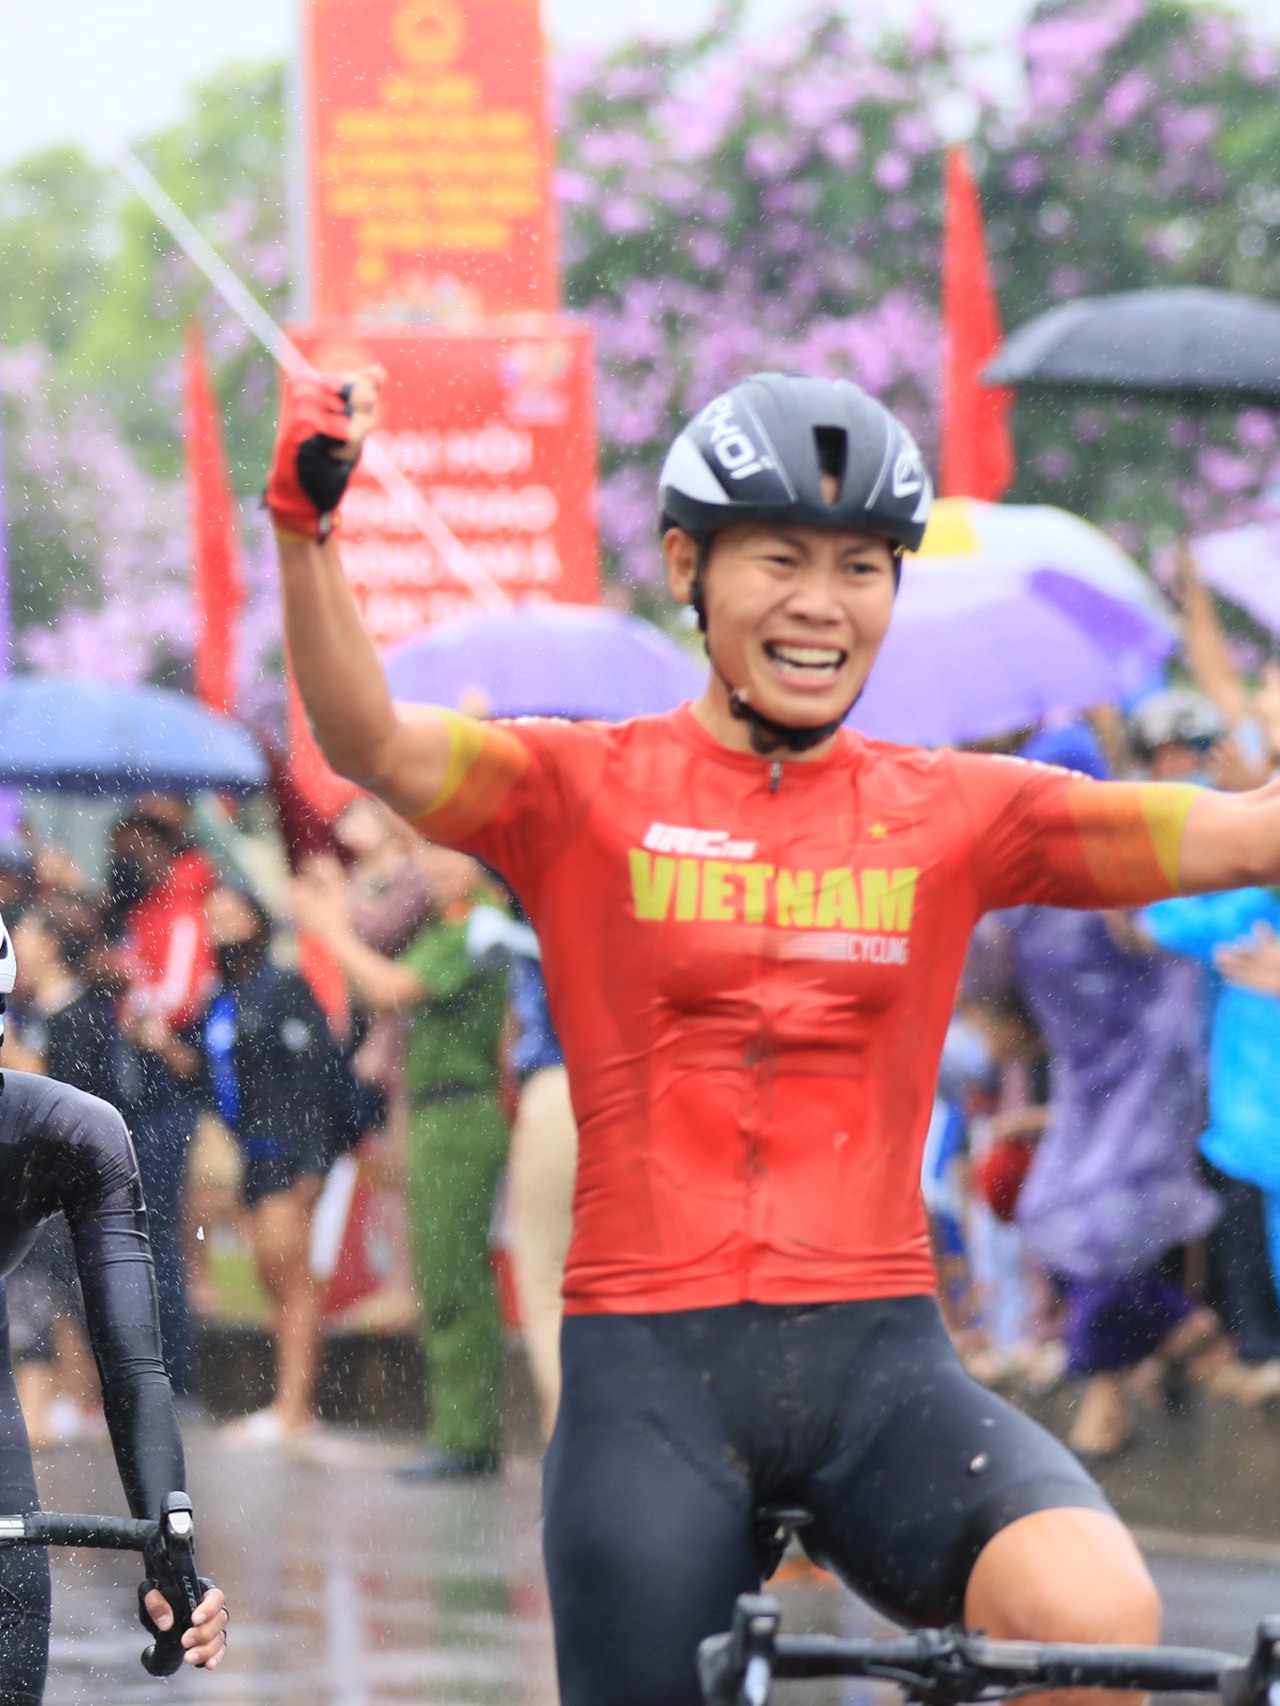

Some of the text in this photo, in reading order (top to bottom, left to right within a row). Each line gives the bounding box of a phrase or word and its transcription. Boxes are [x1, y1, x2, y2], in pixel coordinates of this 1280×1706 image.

[628, 847, 919, 932] VIETNAM
[848, 934, 910, 966] CYCLING
[183, 1575, 197, 1610] ULTE
